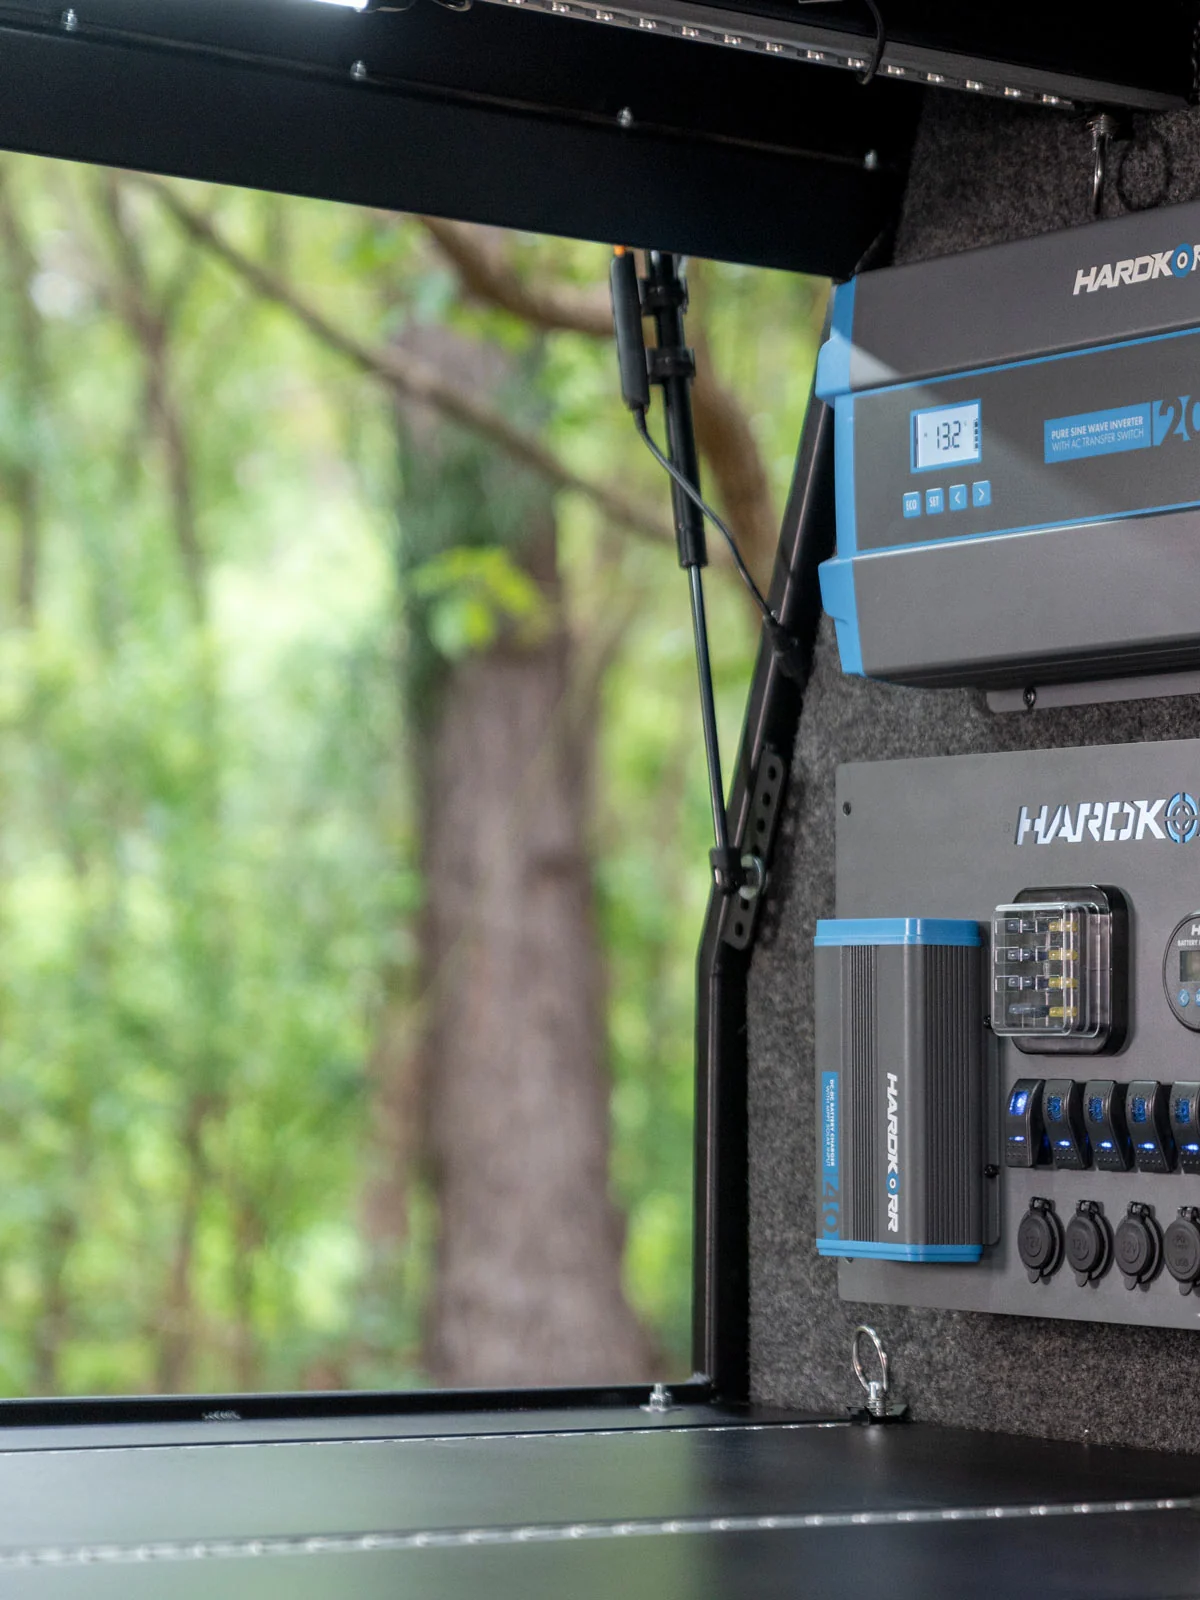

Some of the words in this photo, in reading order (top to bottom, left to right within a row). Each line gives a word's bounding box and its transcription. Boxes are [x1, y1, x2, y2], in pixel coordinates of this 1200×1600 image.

[1051, 428, 1069, 440] PURE
[1070, 425, 1087, 437] SINE
[1087, 421, 1109, 433] WAVE
[1109, 415, 1144, 430] INVERTER
[1051, 440, 1070, 452] WITH
[1071, 438, 1081, 449] AC
[1082, 432, 1116, 447] TRANSFER
[1116, 427, 1144, 442] SWITCH
[906, 499, 917, 511] ECO
[929, 495, 939, 507] SET
[1177, 939, 1198, 947] BATTERY
[886, 1072, 899, 1233] HARDKORR
